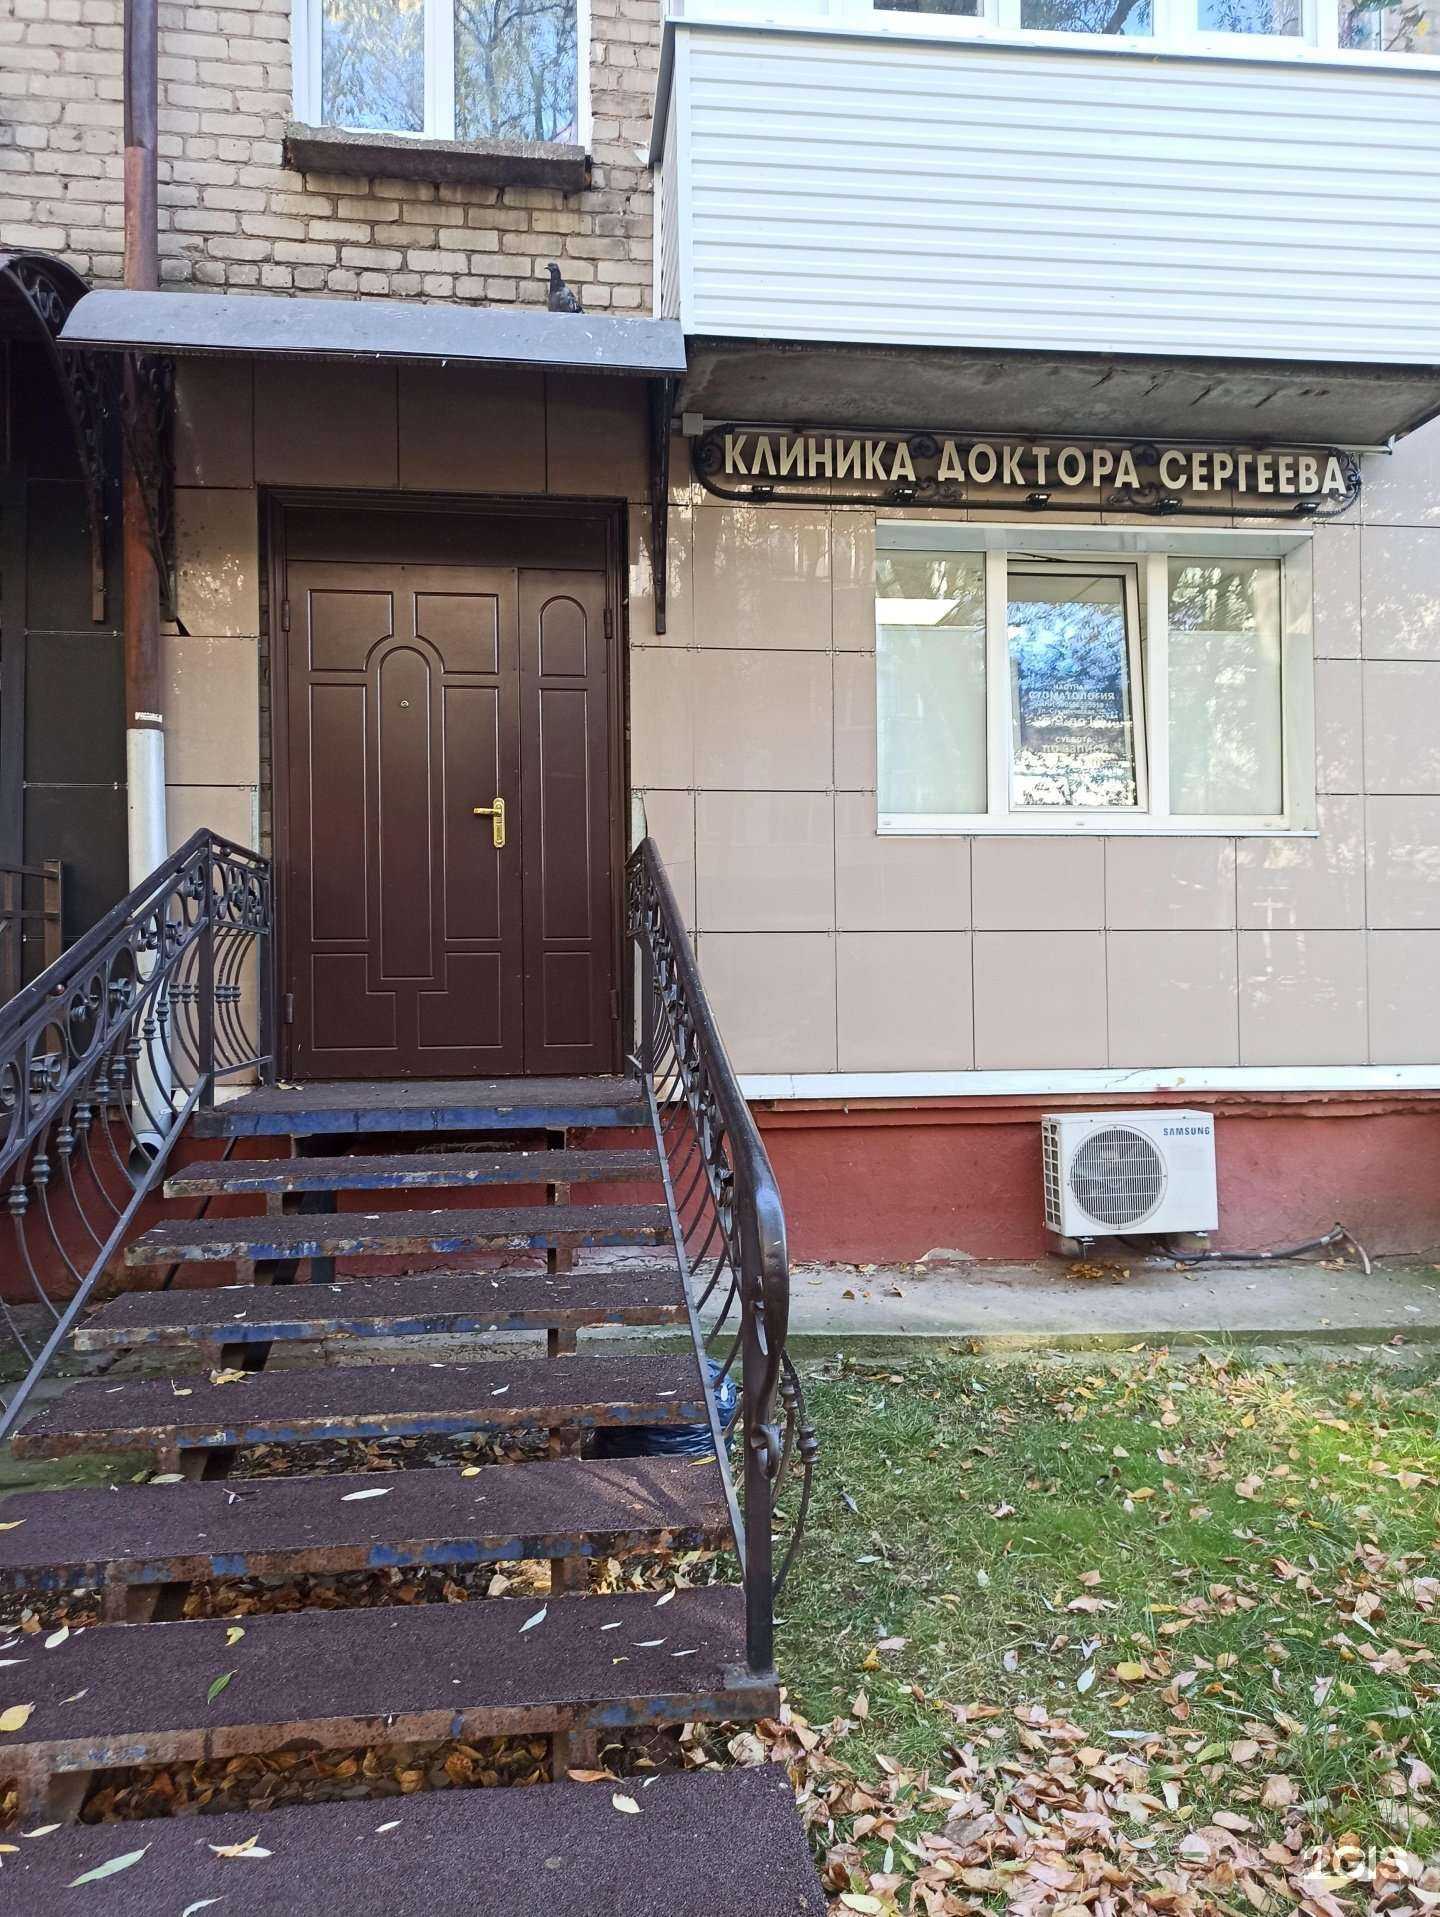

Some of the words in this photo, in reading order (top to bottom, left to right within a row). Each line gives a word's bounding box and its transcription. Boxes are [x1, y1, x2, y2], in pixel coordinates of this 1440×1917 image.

[725, 434, 916, 481] КЛИНИКА
[938, 440, 1140, 489] ДОКТОРА
[1159, 450, 1348, 495] СЕРГЕЕВА
[1029, 691, 1115, 700] СТОМАТОЛОГИЯ
[1162, 1126, 1211, 1136] SAMSUNG
